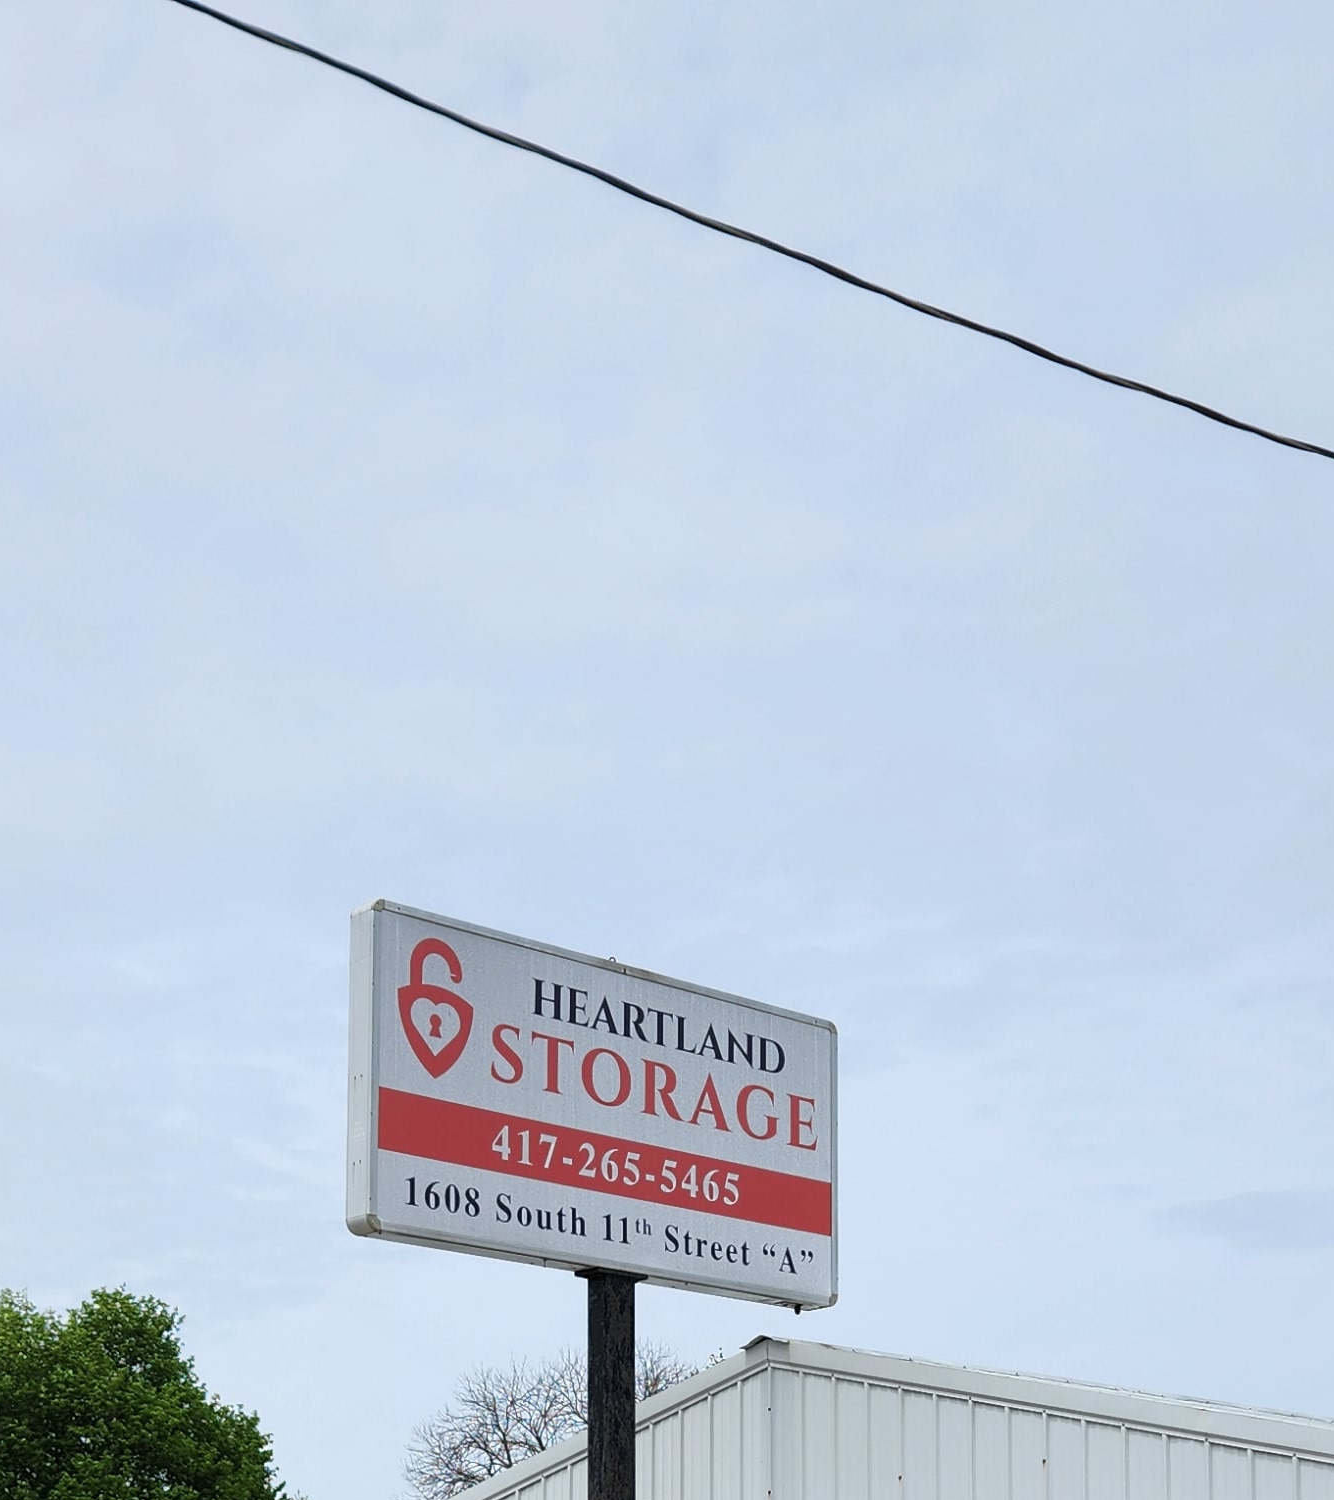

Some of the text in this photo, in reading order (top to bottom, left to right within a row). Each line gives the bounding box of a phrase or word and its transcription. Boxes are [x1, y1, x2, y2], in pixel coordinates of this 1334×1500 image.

[532, 978, 786, 1074] HEARTLAND
[490, 1023, 819, 1152] STORAGE
[491, 1124, 741, 1206] 417-265-5465
[404, 1176, 481, 1218] 1608
[495, 1192, 587, 1238] South
[602, 1212, 652, 1245] 11th
[663, 1225, 751, 1267] Street
